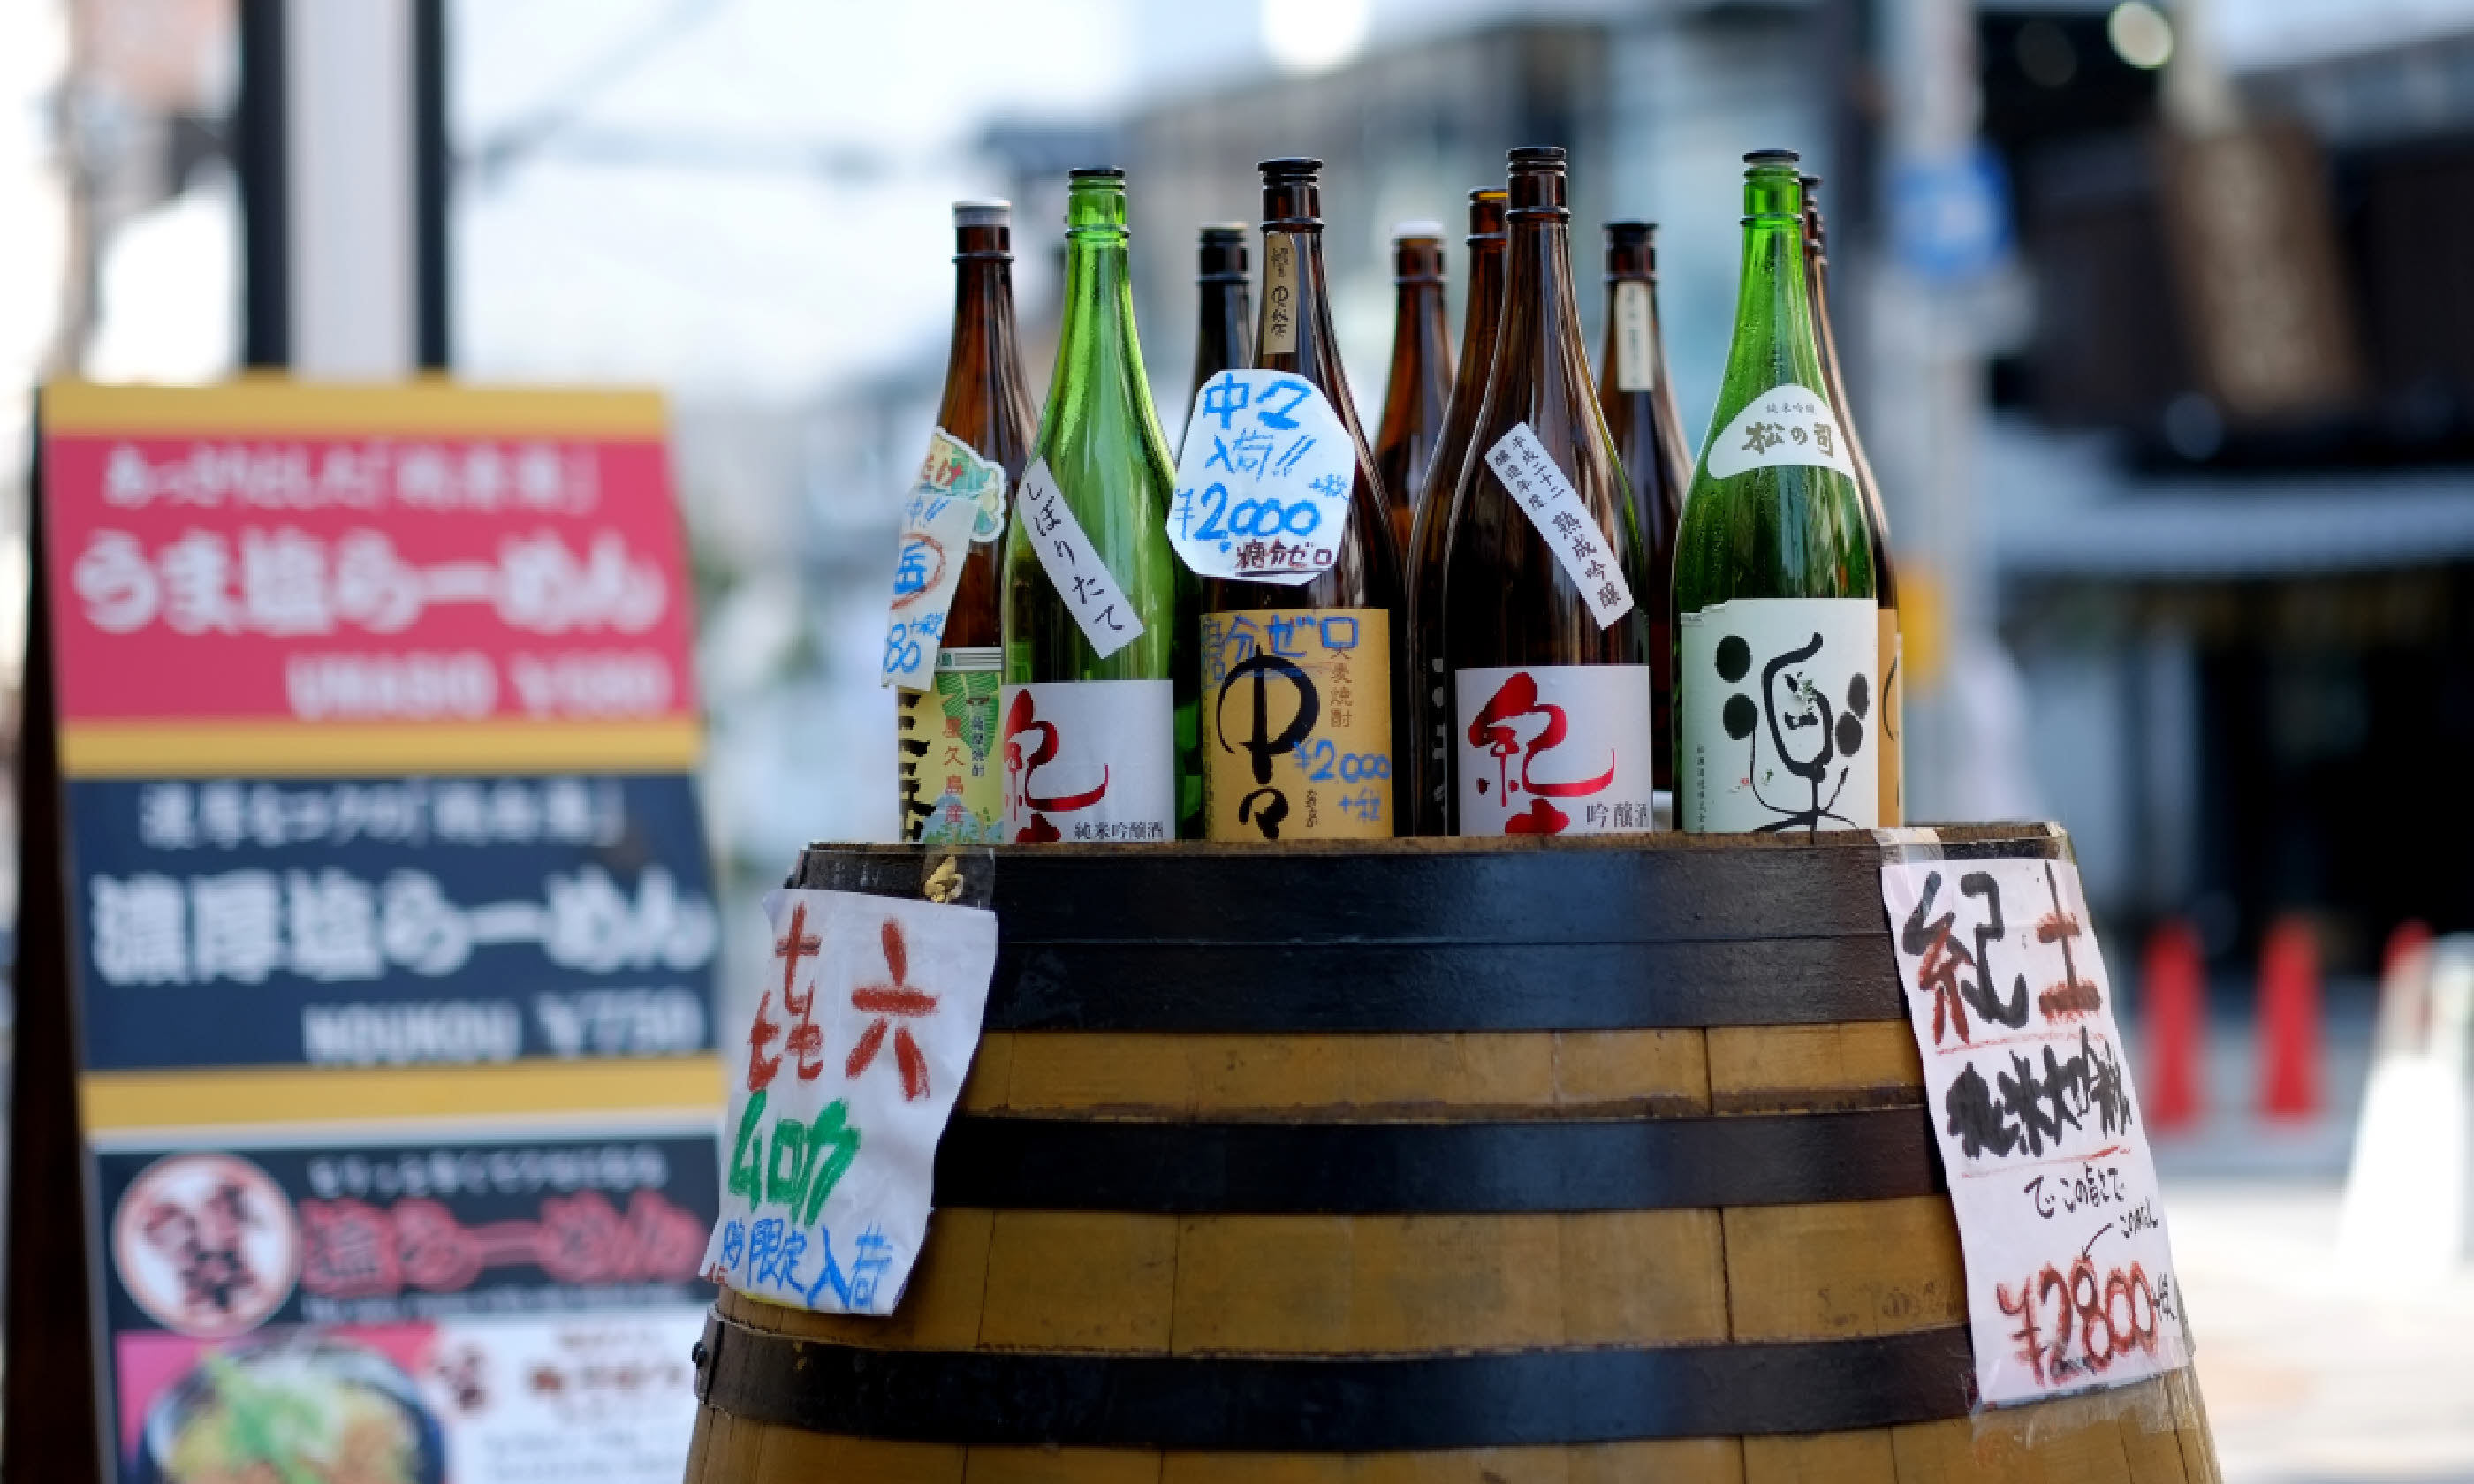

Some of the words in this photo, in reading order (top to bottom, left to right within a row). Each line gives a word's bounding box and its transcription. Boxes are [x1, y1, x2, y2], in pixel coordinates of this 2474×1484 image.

[1742, 421, 1834, 458] 松の司
[1027, 481, 1125, 631] しぼりたて
[1902, 859, 2103, 1046] 紀土
